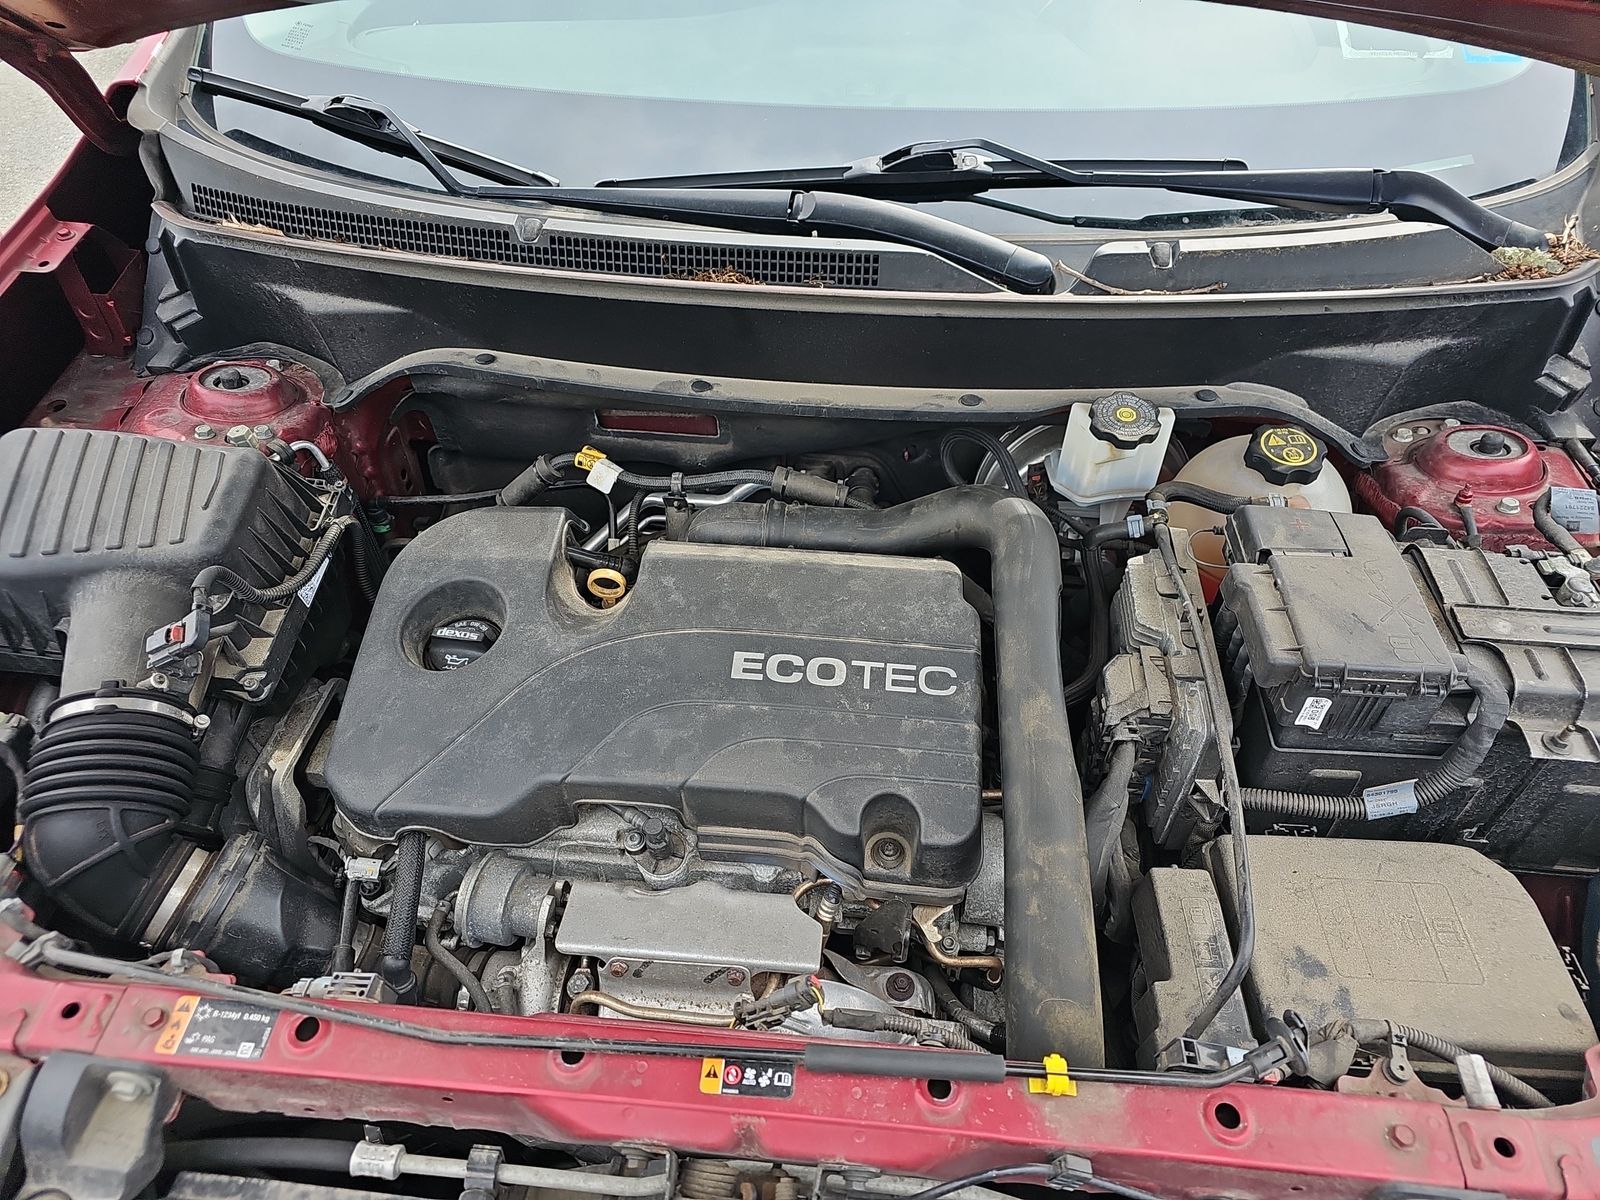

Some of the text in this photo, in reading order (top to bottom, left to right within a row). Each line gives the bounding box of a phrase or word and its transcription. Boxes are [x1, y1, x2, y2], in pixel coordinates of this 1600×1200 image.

[436, 627, 480, 640] dexos
[730, 651, 958, 696] ECOTEC
[261, 1014, 271, 1024] kg
